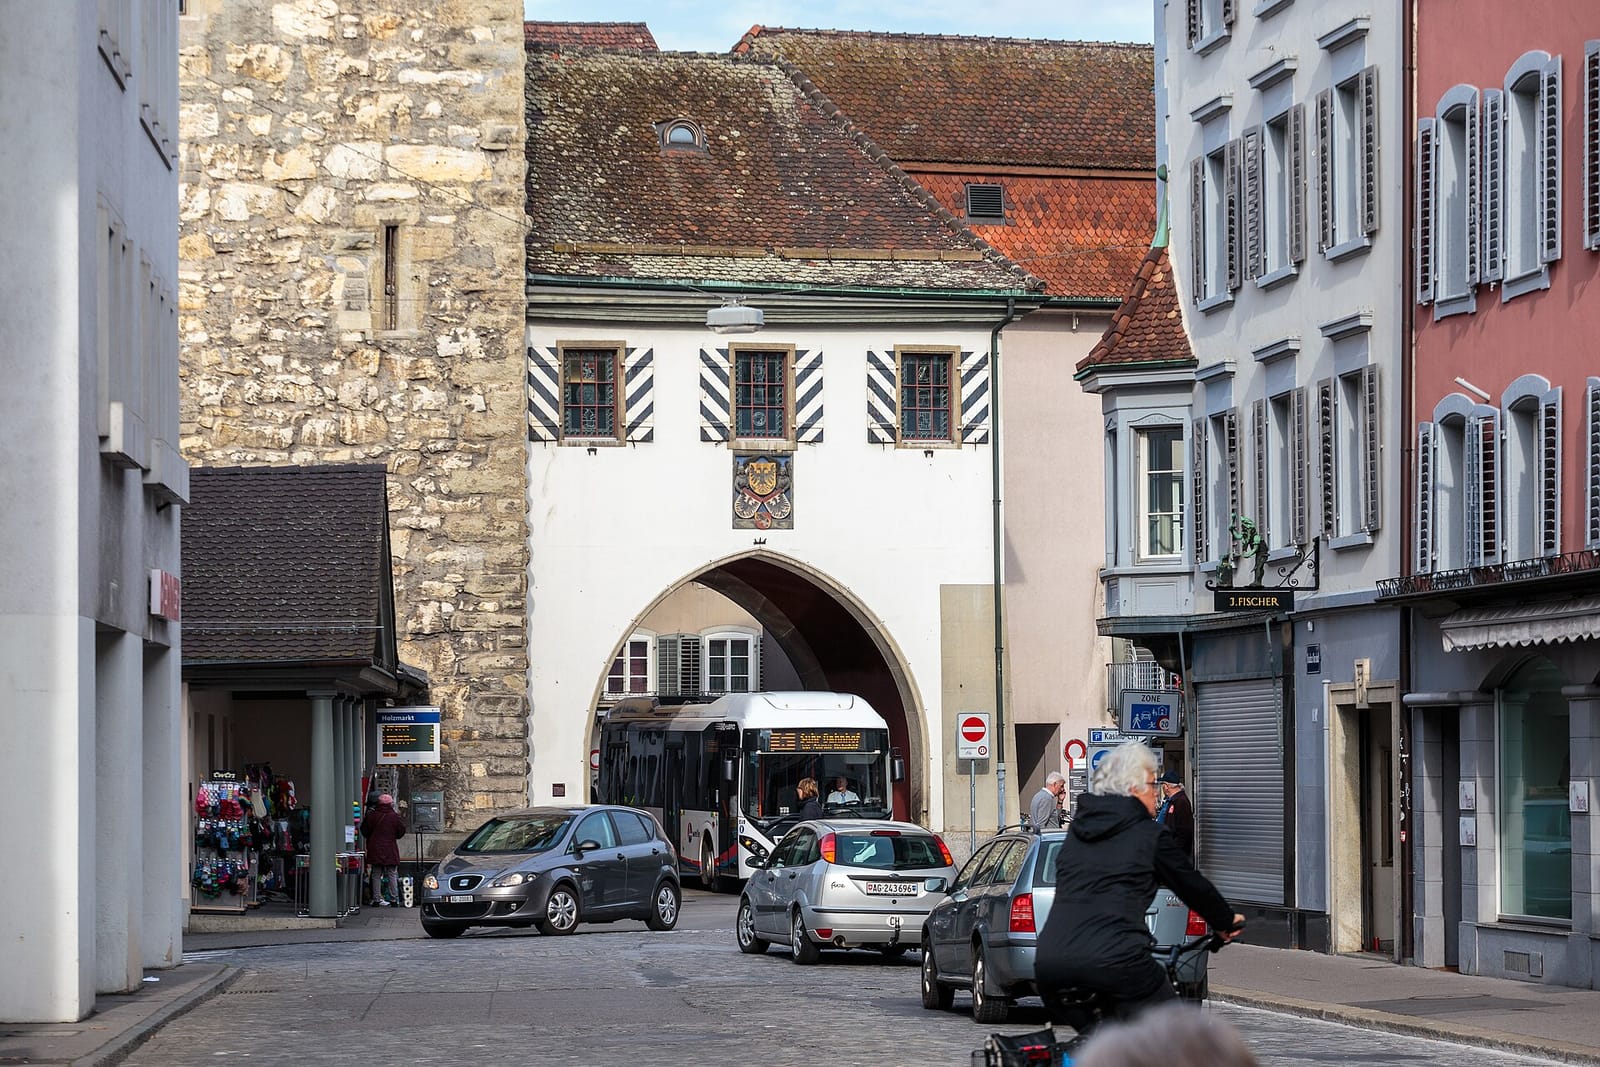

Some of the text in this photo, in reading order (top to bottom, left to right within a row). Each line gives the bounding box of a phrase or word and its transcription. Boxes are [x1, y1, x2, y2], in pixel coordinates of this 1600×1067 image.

[1229, 597, 1280, 607] J.FISCHER
[1141, 694, 1161, 703] ZONE
[381, 714, 415, 722] Holzmarkt
[889, 916, 901, 927] CH
